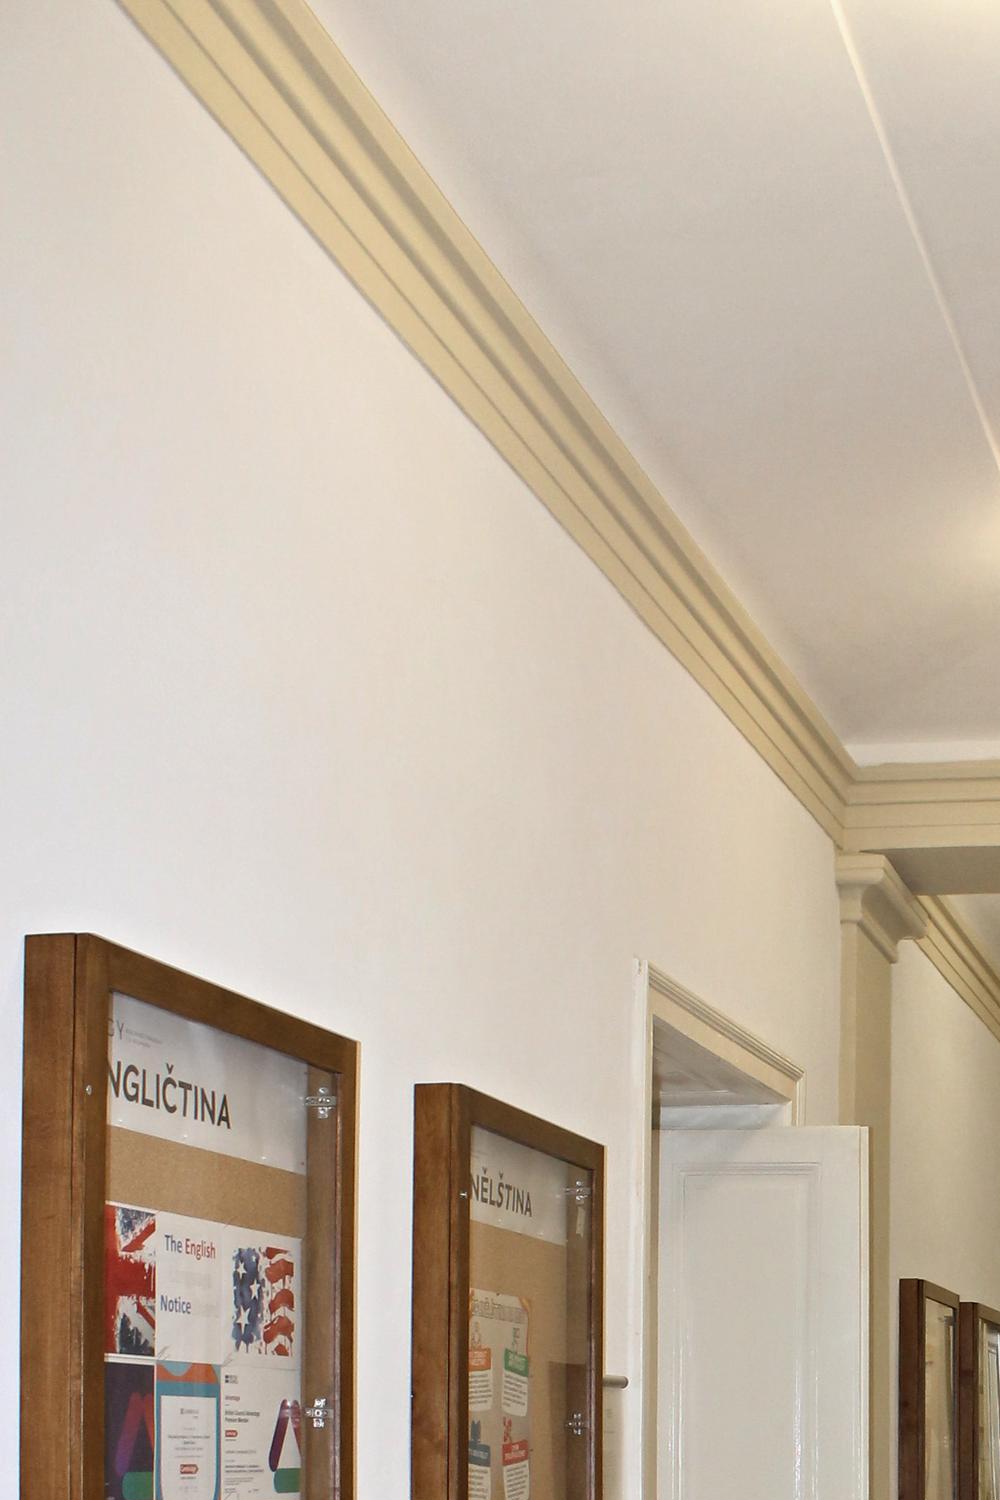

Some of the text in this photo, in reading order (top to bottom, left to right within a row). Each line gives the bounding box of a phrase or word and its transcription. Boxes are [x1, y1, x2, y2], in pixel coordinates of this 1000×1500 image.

[164, 1234, 216, 1260] The English
[160, 1295, 191, 1315] Notice
